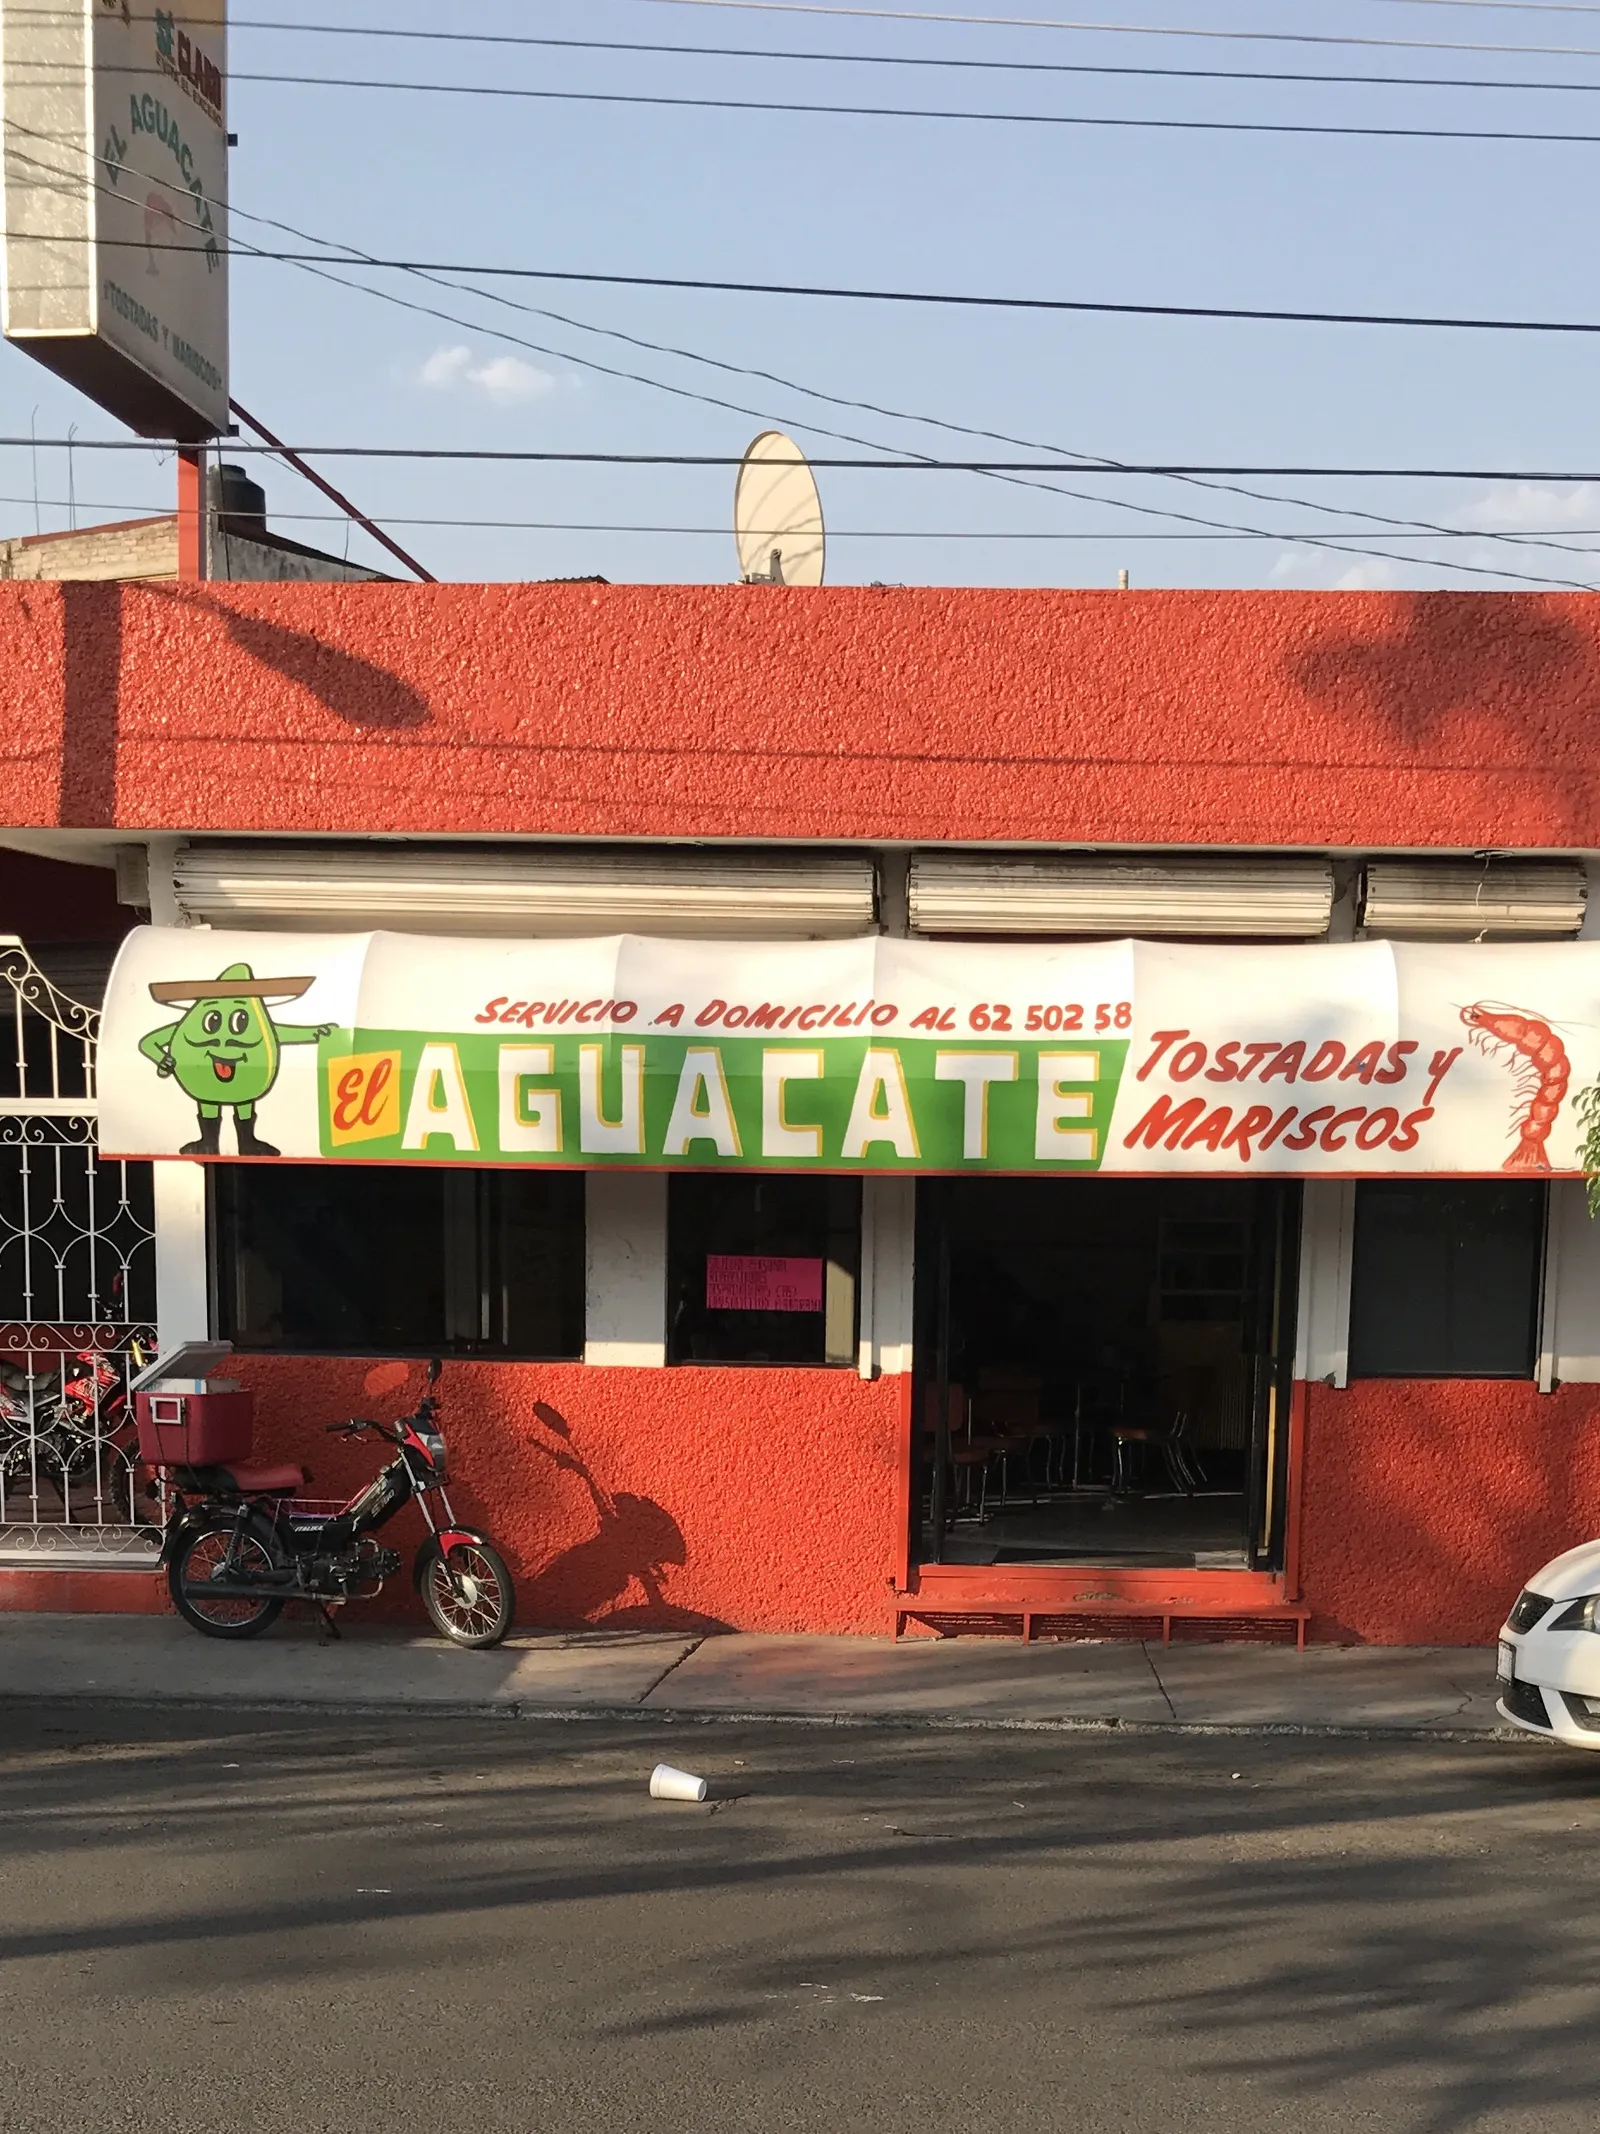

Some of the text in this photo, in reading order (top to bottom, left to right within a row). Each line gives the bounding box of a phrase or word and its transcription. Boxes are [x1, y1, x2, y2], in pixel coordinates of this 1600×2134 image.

[130, 94, 219, 273] AGUACATE
[474, 997, 1132, 1031] SERVICIO A DOMICILIO AL 62 502 58
[1136, 1029, 1419, 1085] TOSTADAS
[332, 1041, 1100, 1160] El AGUACATE
[1123, 1094, 1435, 1162] MARISCOS
